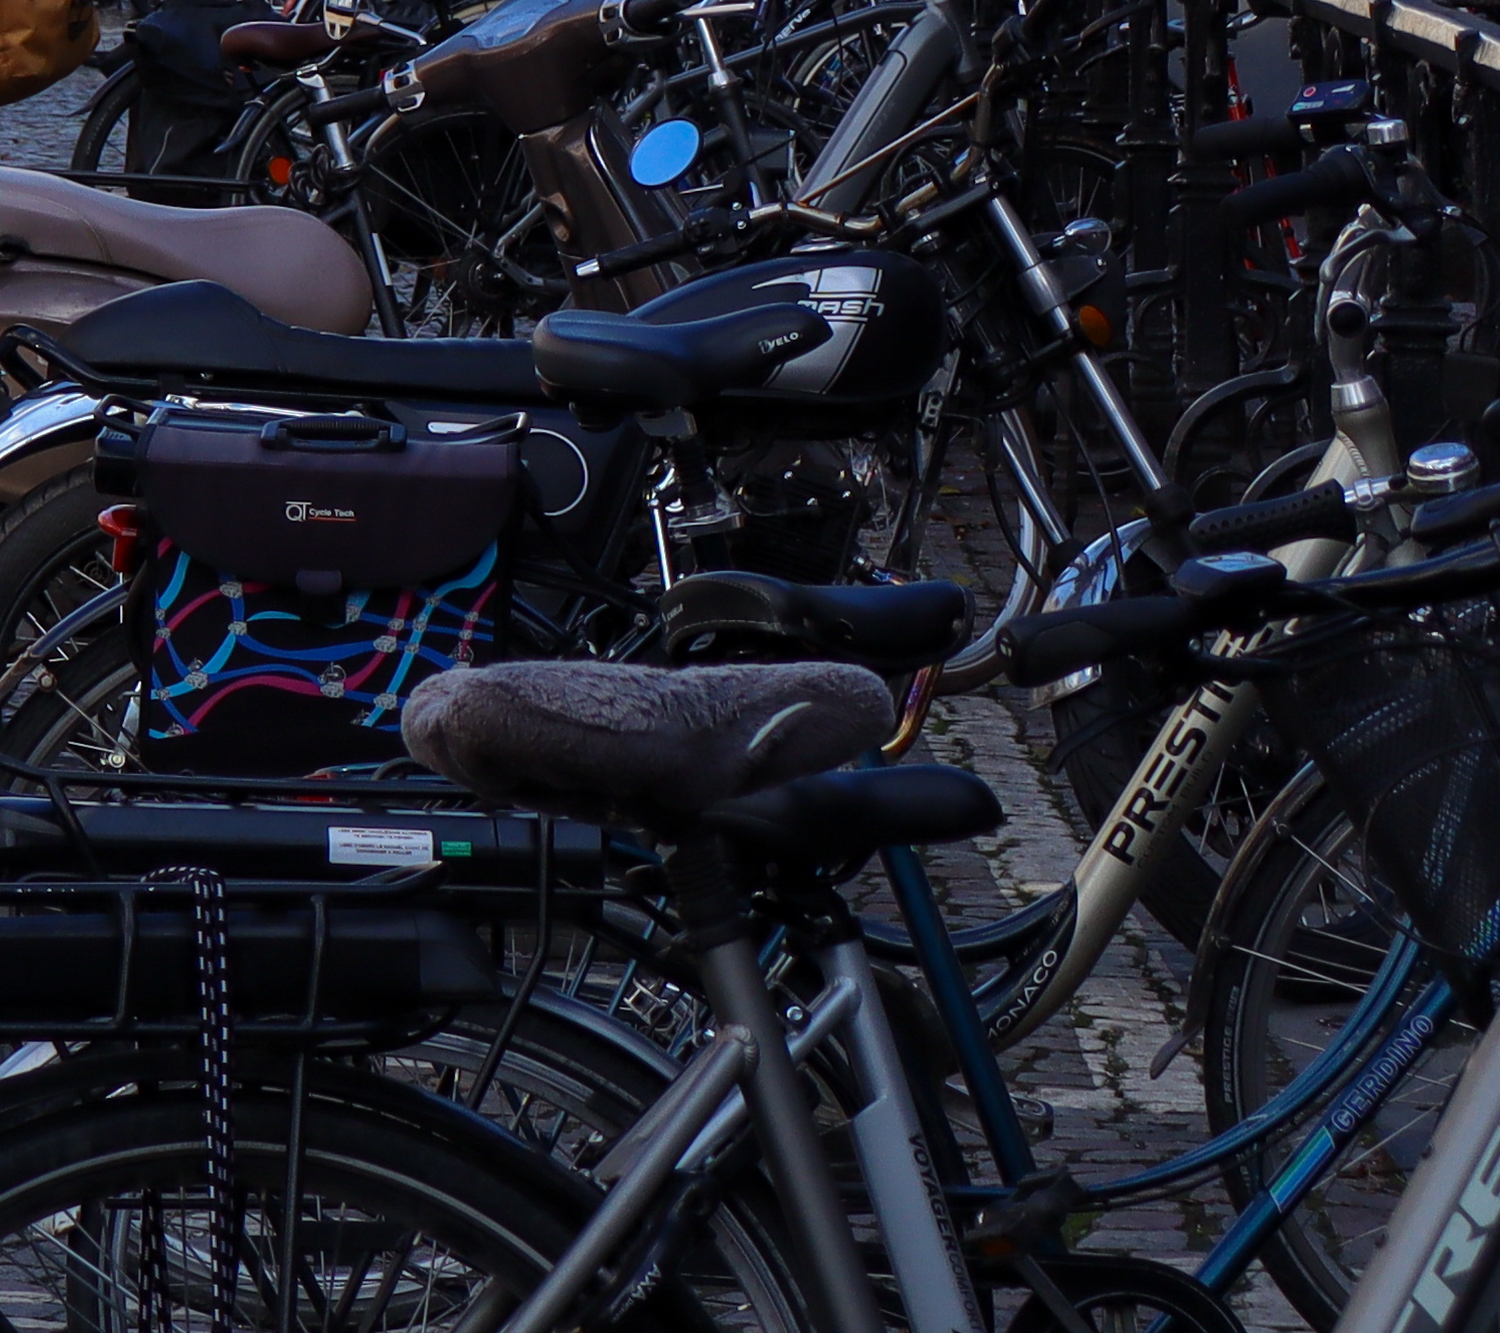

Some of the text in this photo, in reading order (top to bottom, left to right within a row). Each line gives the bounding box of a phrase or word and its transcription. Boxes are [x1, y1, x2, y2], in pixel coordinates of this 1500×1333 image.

[309, 507, 332, 518] Cycle
[334, 508, 355, 518] Tech
[1331, 1014, 1433, 1132] GERDINO
[909, 1133, 957, 1252] VOYAGER
[631, 1262, 662, 1301] AXA
